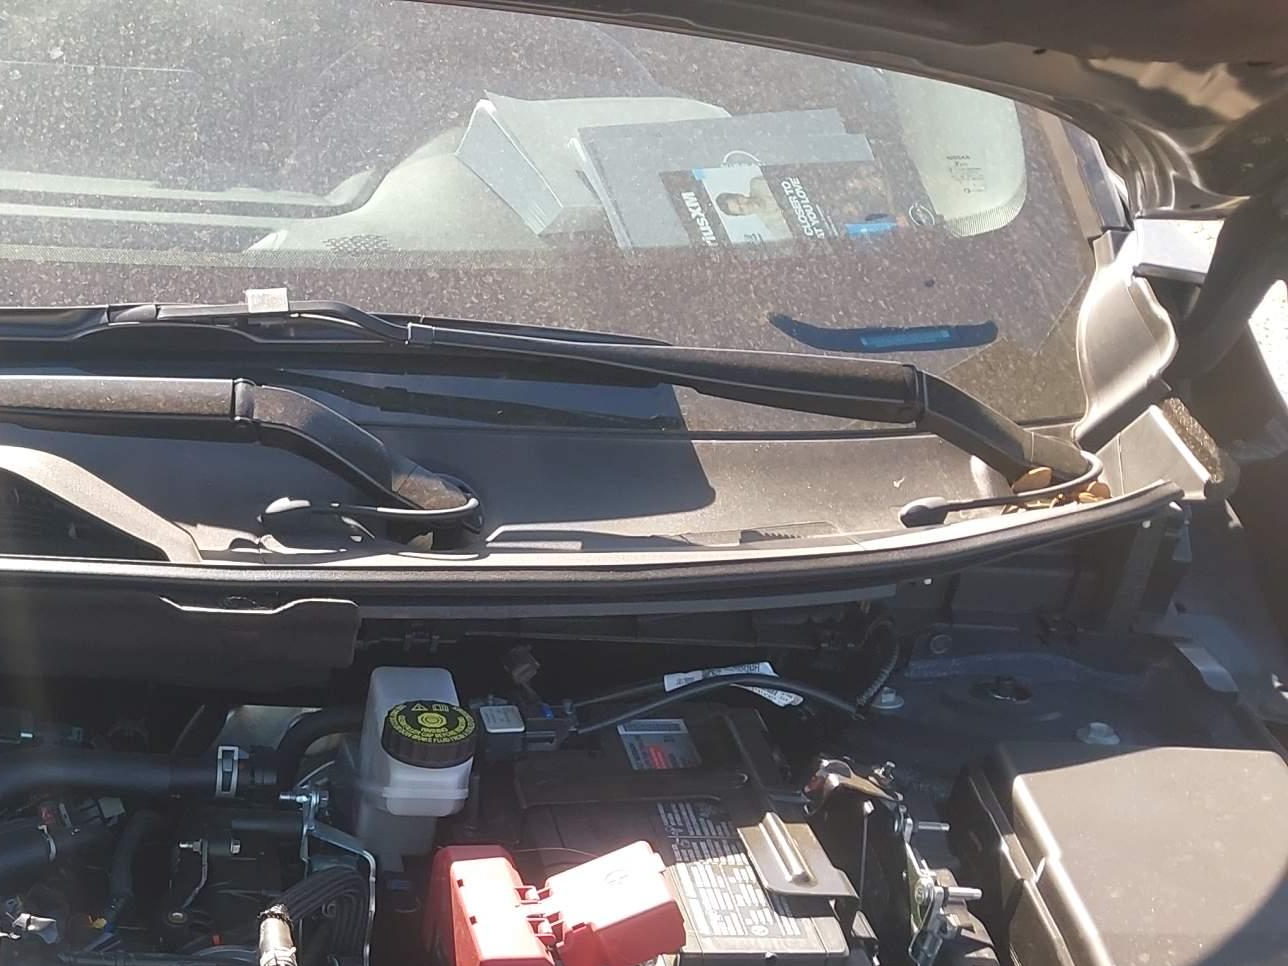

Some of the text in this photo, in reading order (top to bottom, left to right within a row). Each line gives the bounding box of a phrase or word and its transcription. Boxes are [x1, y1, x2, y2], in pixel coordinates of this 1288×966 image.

[781, 180, 794, 196] TO
[788, 177, 810, 203] LOVE
[803, 204, 820, 226] YOU
